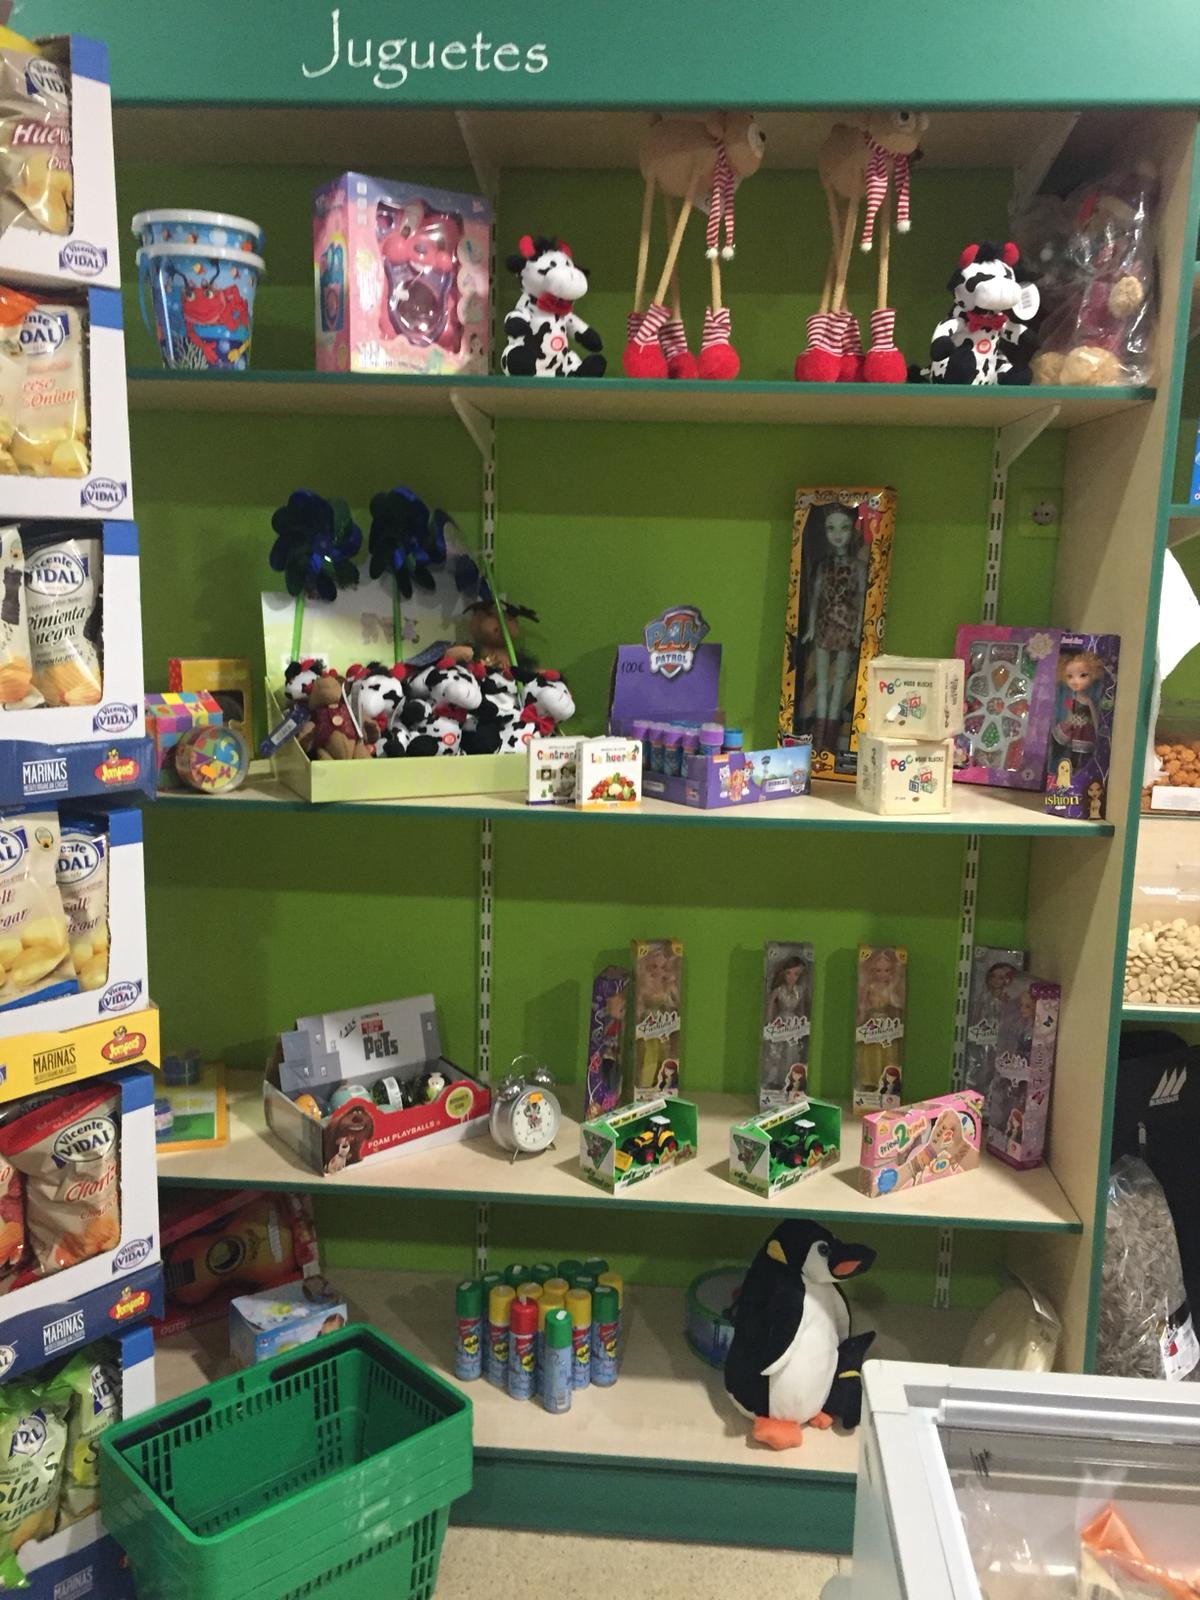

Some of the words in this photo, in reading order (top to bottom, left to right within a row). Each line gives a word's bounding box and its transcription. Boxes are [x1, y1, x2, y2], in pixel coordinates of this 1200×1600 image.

[302, 8, 549, 89] Juguetes
[86, 491, 120, 502] VIDAL
[35, 624, 76, 646] negra
[655, 653, 688, 665] PATROL
[879, 678, 902, 694] ABC
[99, 714, 130, 726] VIDAL
[22, 761, 67, 785] MARINAS
[890, 755, 913, 772] ABC
[104, 991, 136, 1006] VIDAL
[33, 1046, 76, 1075] MARINAS
[59, 1120, 103, 1145] Vicente
[61, 1129, 110, 1157] VIDAL
[368, 1136, 391, 1149] FOAM
[392, 1120, 435, 1141] PLAYBALLS
[894, 1123, 911, 1148] 2
[117, 1248, 146, 1266] VIDAL
[43, 1313, 85, 1346] MARINAS
